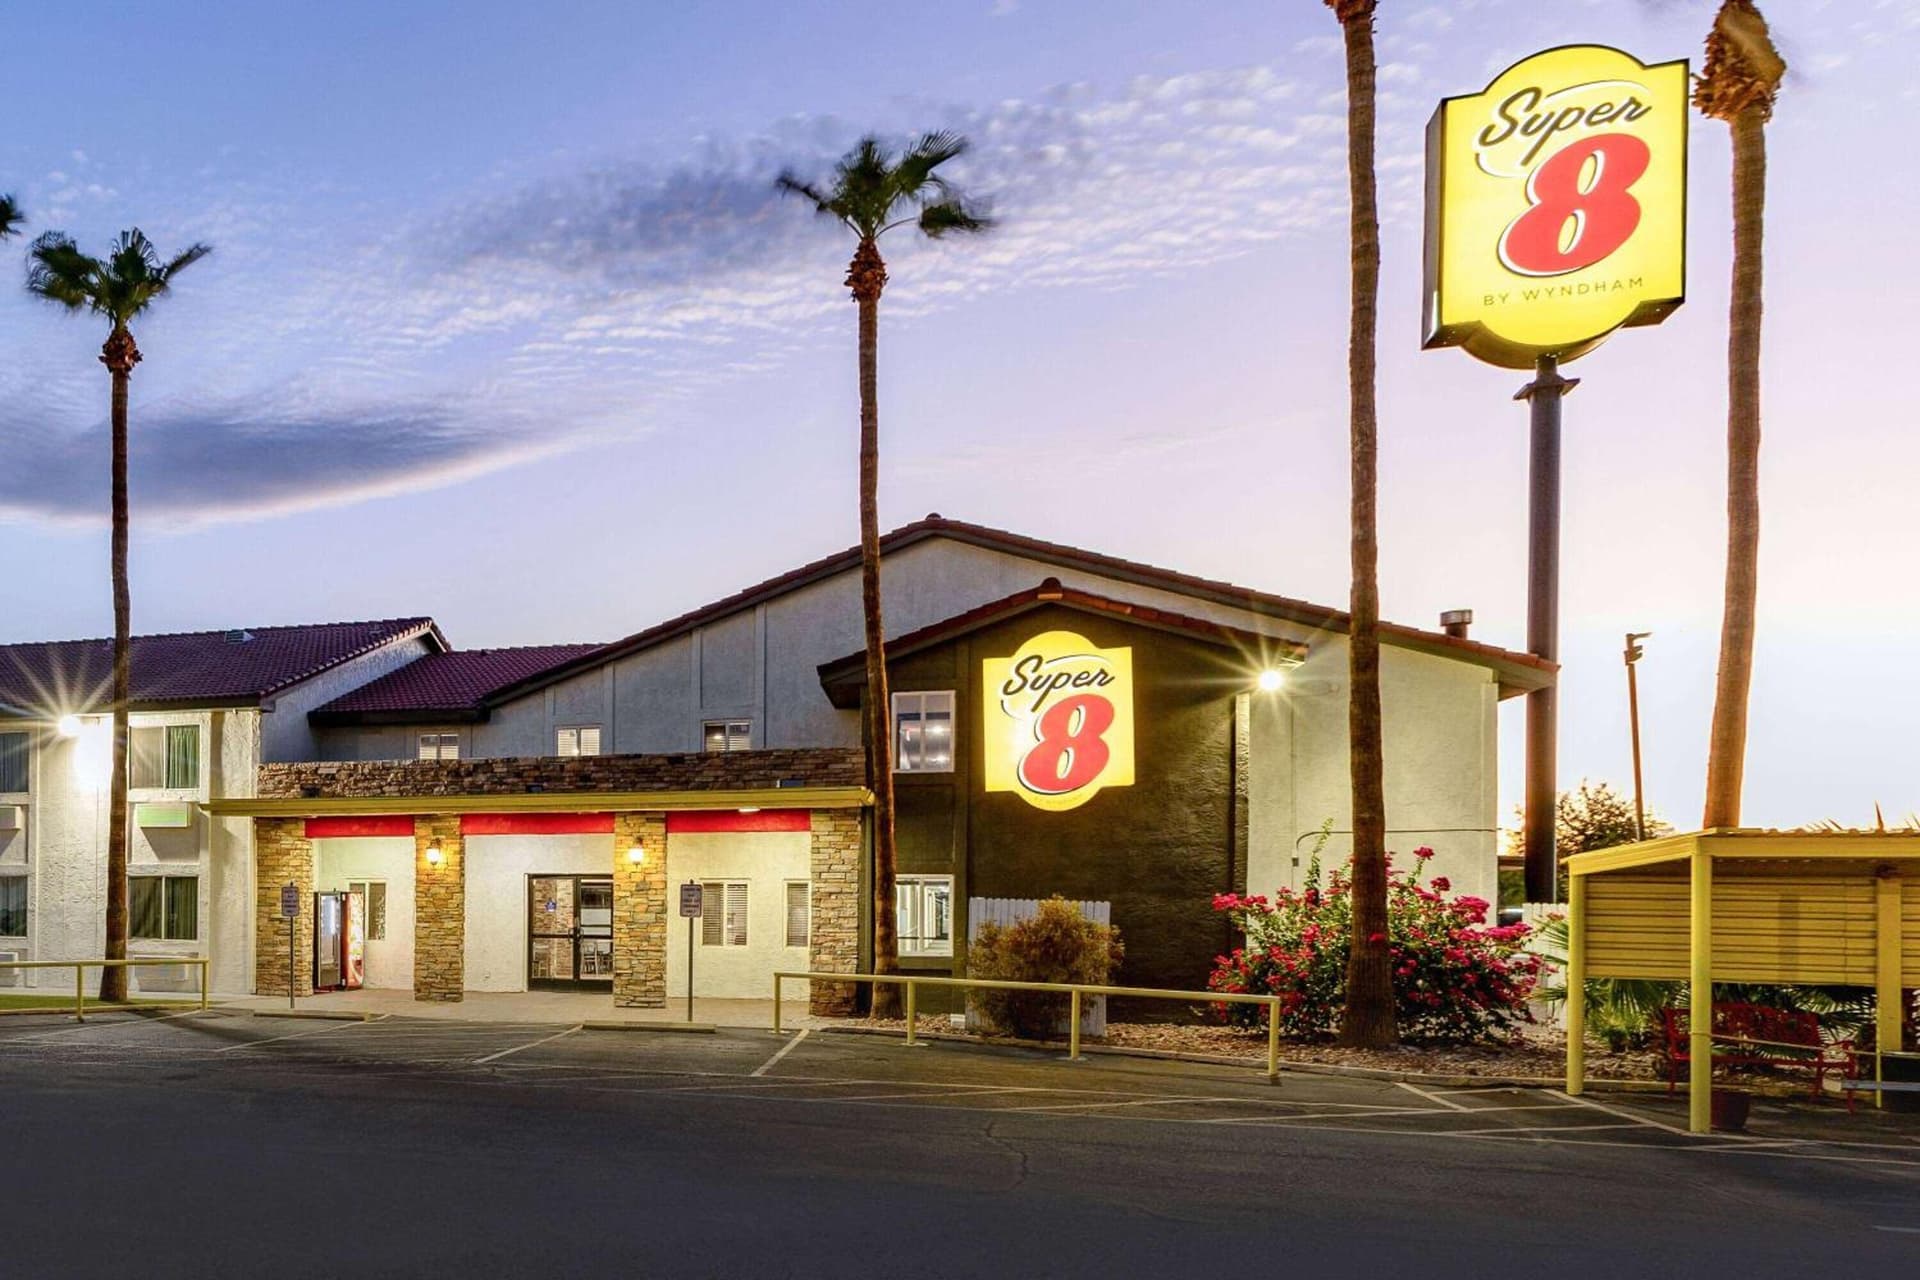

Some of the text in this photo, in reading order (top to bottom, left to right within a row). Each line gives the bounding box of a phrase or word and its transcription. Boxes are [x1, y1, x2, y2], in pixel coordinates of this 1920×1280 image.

[1477, 86, 1652, 167] Super
[1499, 132, 1651, 276] 8
[1483, 276, 1644, 306] BY WYNDHAM
[1002, 654, 1116, 713] Super
[1018, 693, 1115, 794] 8
